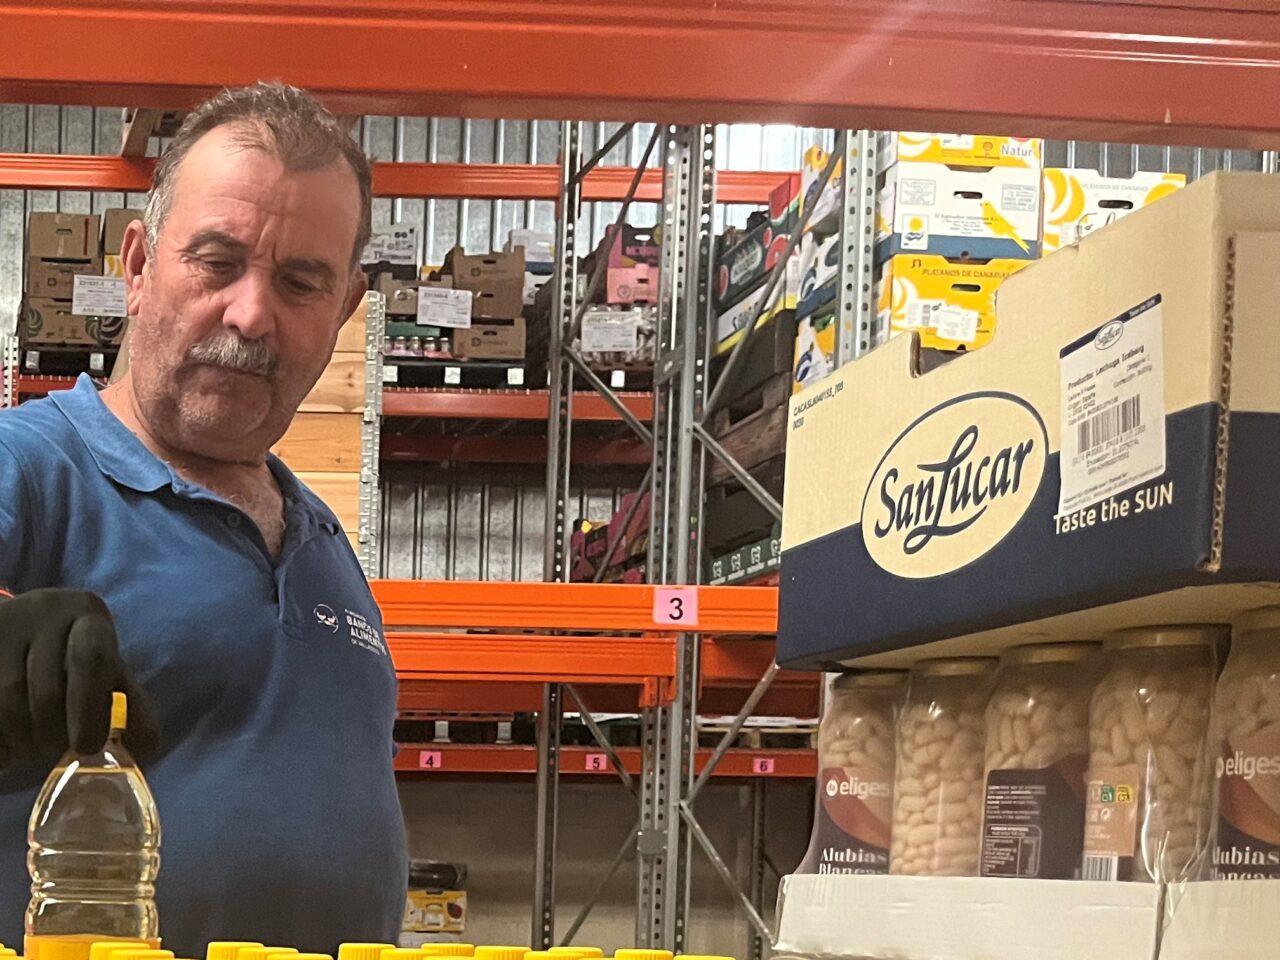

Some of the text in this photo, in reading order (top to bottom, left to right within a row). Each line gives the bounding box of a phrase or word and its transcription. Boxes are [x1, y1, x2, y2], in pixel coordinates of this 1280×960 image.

[1001, 144, 1033, 158] Natur
[874, 424, 1034, 555] SanLucar
[1053, 507, 1096, 535] Taste
[1101, 496, 1130, 522] the
[1134, 481, 1173, 513] SUN
[668, 597, 684, 621] 3
[424, 754, 435, 768] 4
[591, 756, 601, 770] 5
[759, 759, 769, 772] 6
[1225, 751, 1280, 780] eliges
[839, 776, 890, 800] eliges
[820, 847, 888, 864] Alubias
